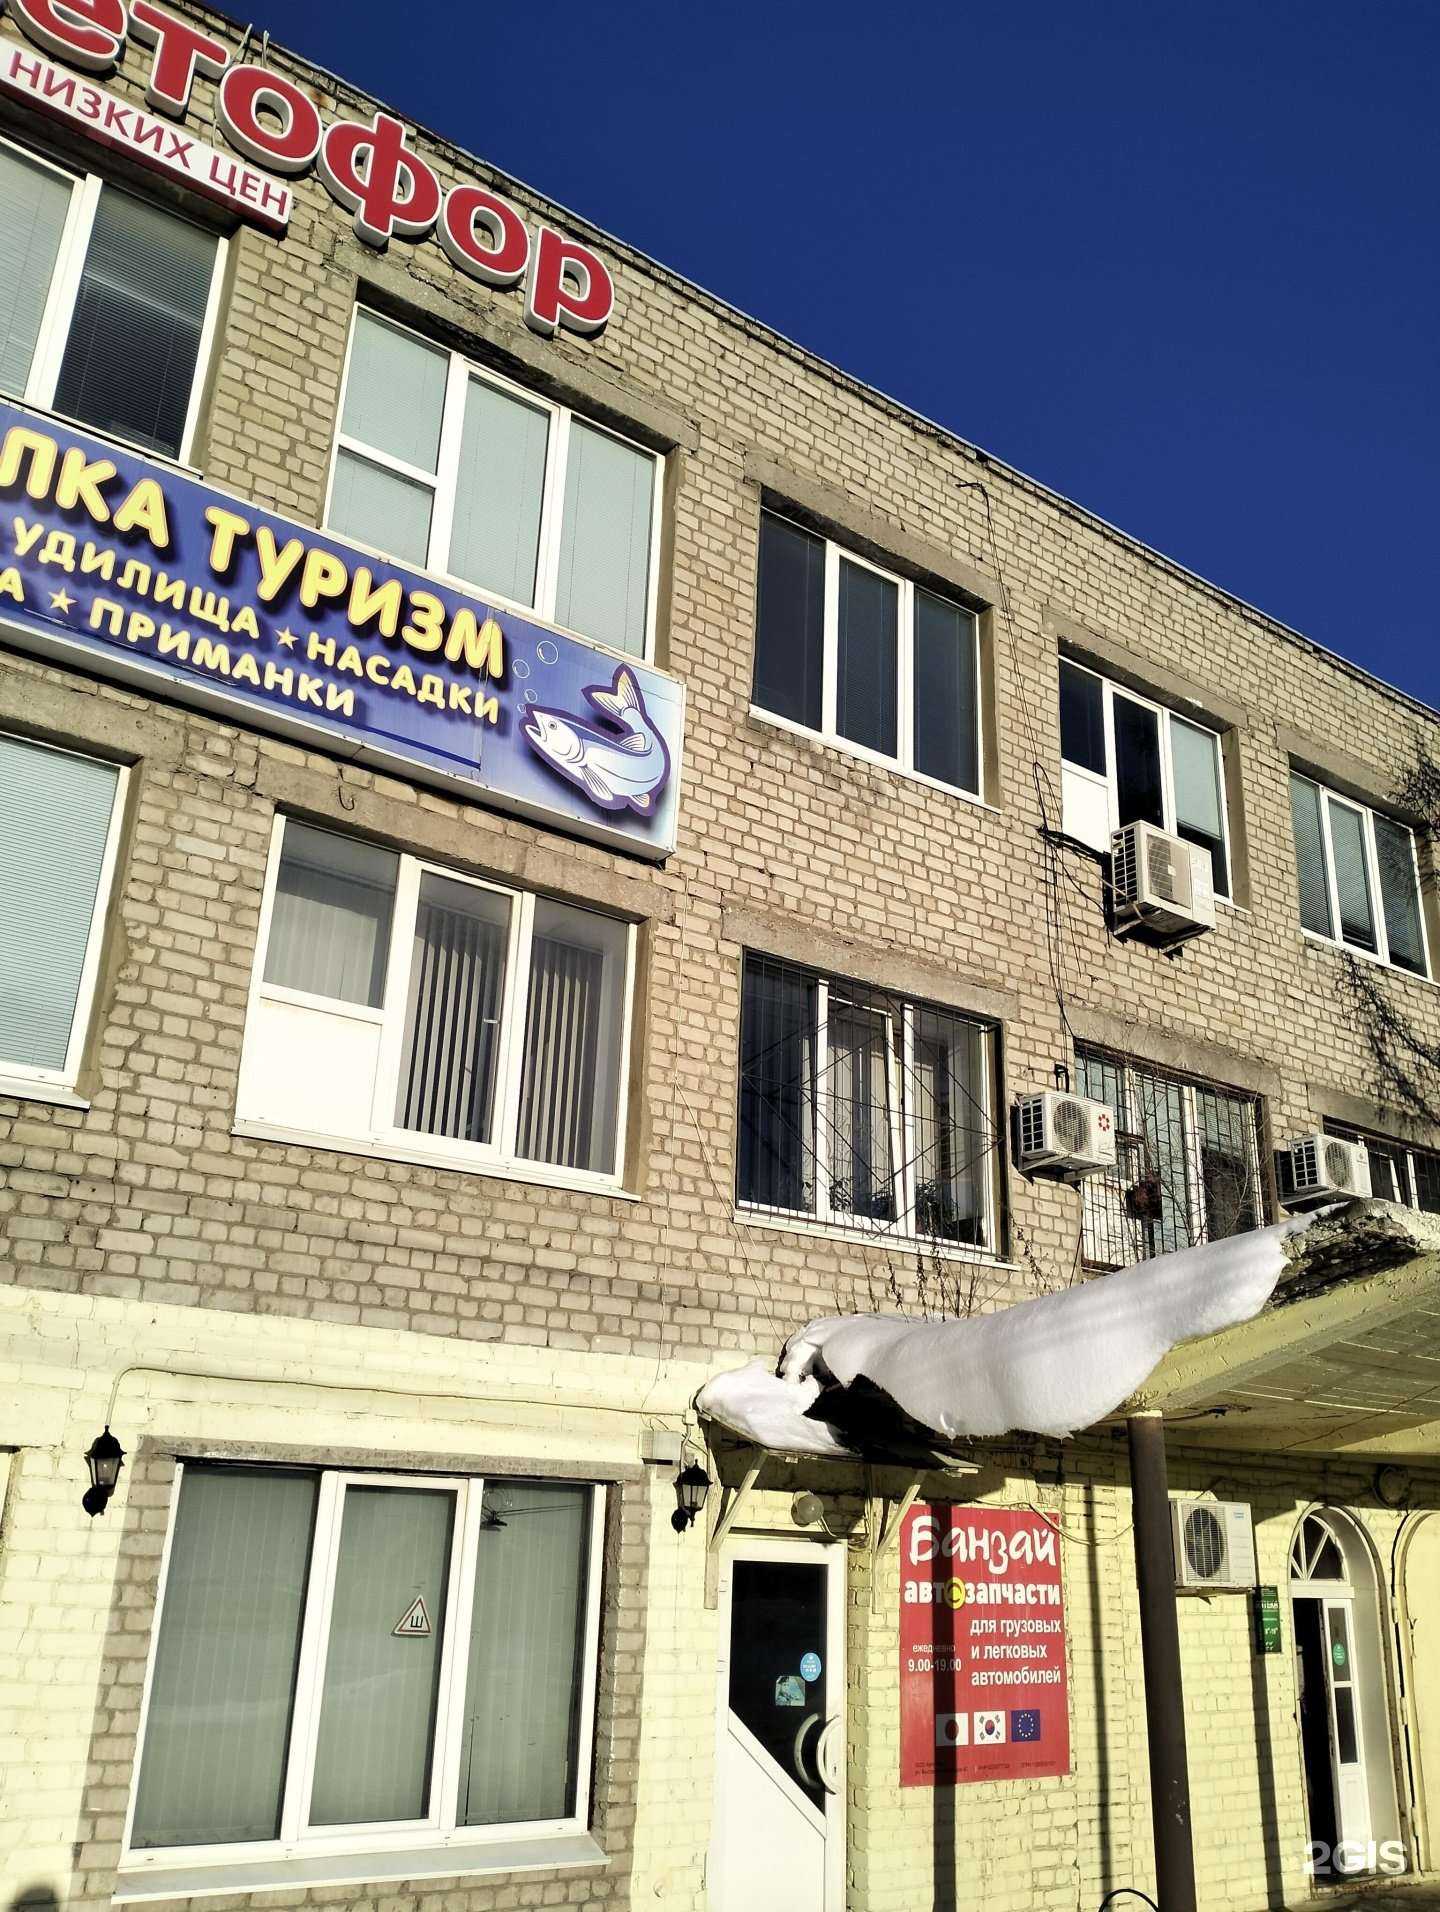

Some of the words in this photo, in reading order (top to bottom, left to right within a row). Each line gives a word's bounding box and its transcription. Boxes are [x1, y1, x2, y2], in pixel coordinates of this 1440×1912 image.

[9, 49, 194, 169] НИЗКИХ
[209, 155, 289, 217] ЦЕН
[204, 505, 505, 679] ТУРИЗМ
[13, 516, 260, 640] УДИЛИЩА
[307, 636, 500, 725] НАСАДКИ
[89, 597, 356, 717] ПРИМАНКИ
[909, 1515, 1057, 1575] Банзай
[904, 1578, 1061, 1609] автозапчасти
[410, 1615, 424, 1628] Ш
[970, 1619, 997, 1637] для
[1000, 1618, 1062, 1638] грузовых
[908, 1658, 962, 1672] 9.00-19.00
[971, 1645, 980, 1660] и
[983, 1644, 1048, 1660] легковых
[971, 1665, 1062, 1686] автомобилей
